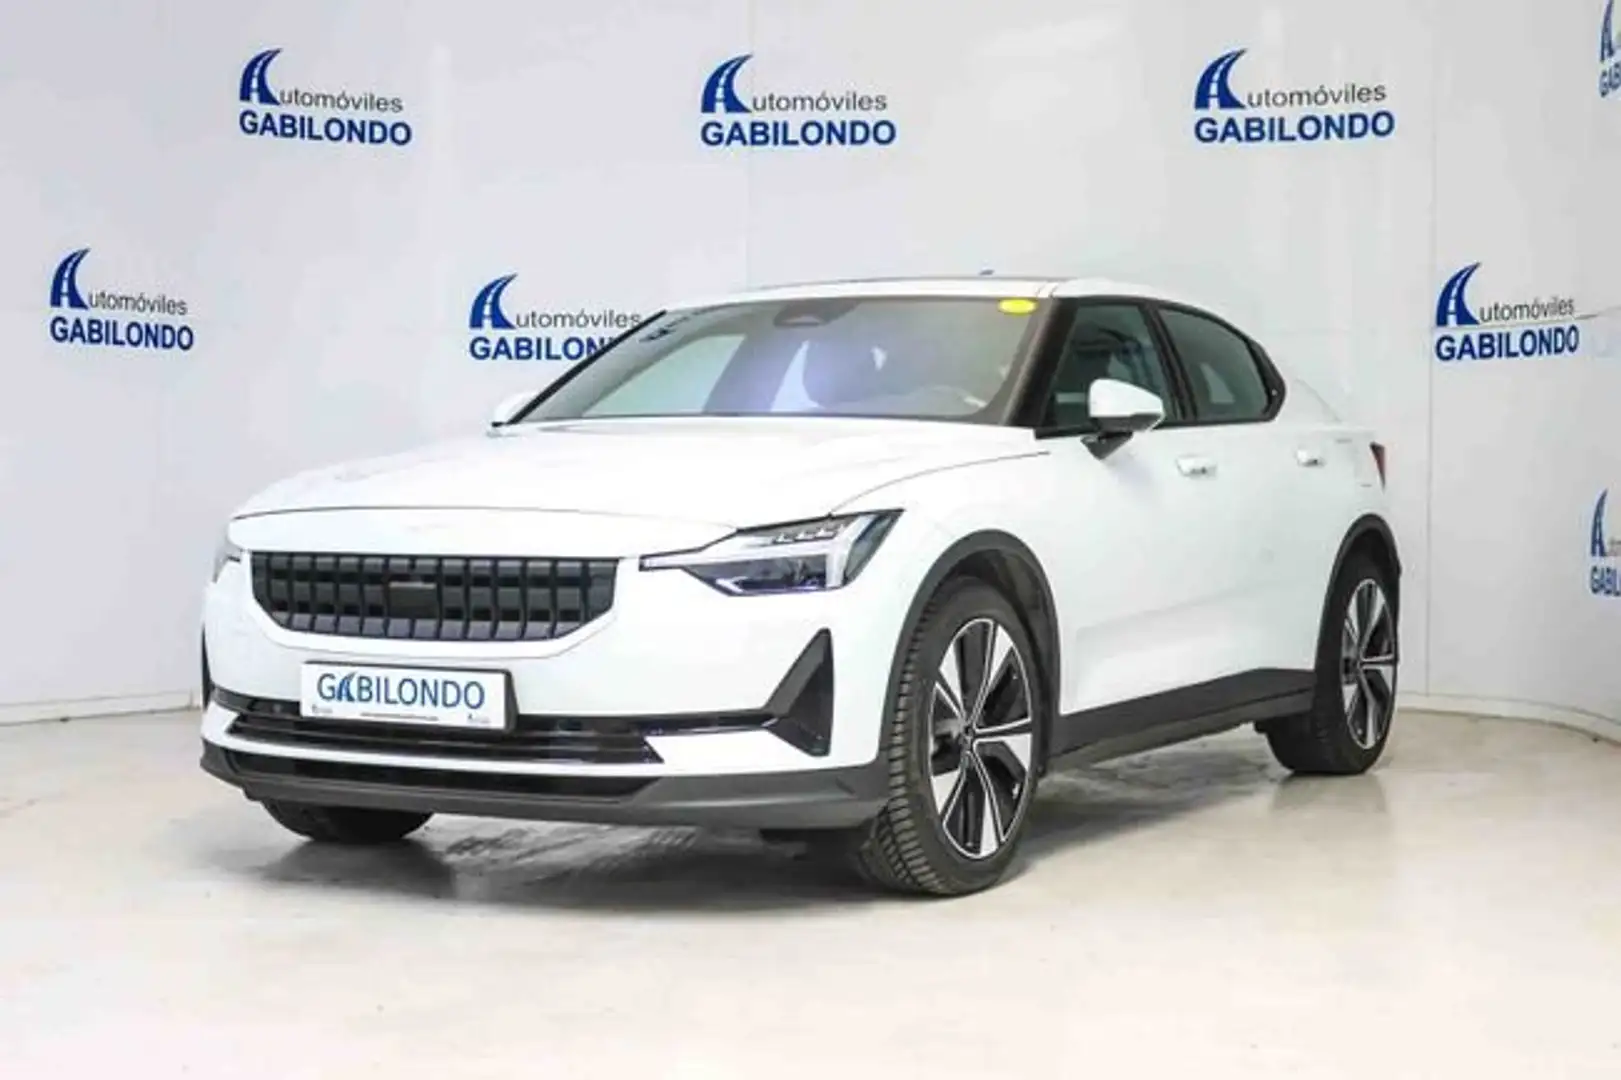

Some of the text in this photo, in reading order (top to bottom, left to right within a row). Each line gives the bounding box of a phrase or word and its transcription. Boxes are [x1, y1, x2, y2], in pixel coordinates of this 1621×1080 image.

[239, 110, 412, 146] GABILONDO
[700, 120, 896, 146] GABILONDO
[1194, 110, 1395, 143] GABILONDO
[50, 316, 194, 351] GABILONDO
[1435, 324, 1580, 361] GABILONDO
[317, 671, 485, 709] GABILONDO
